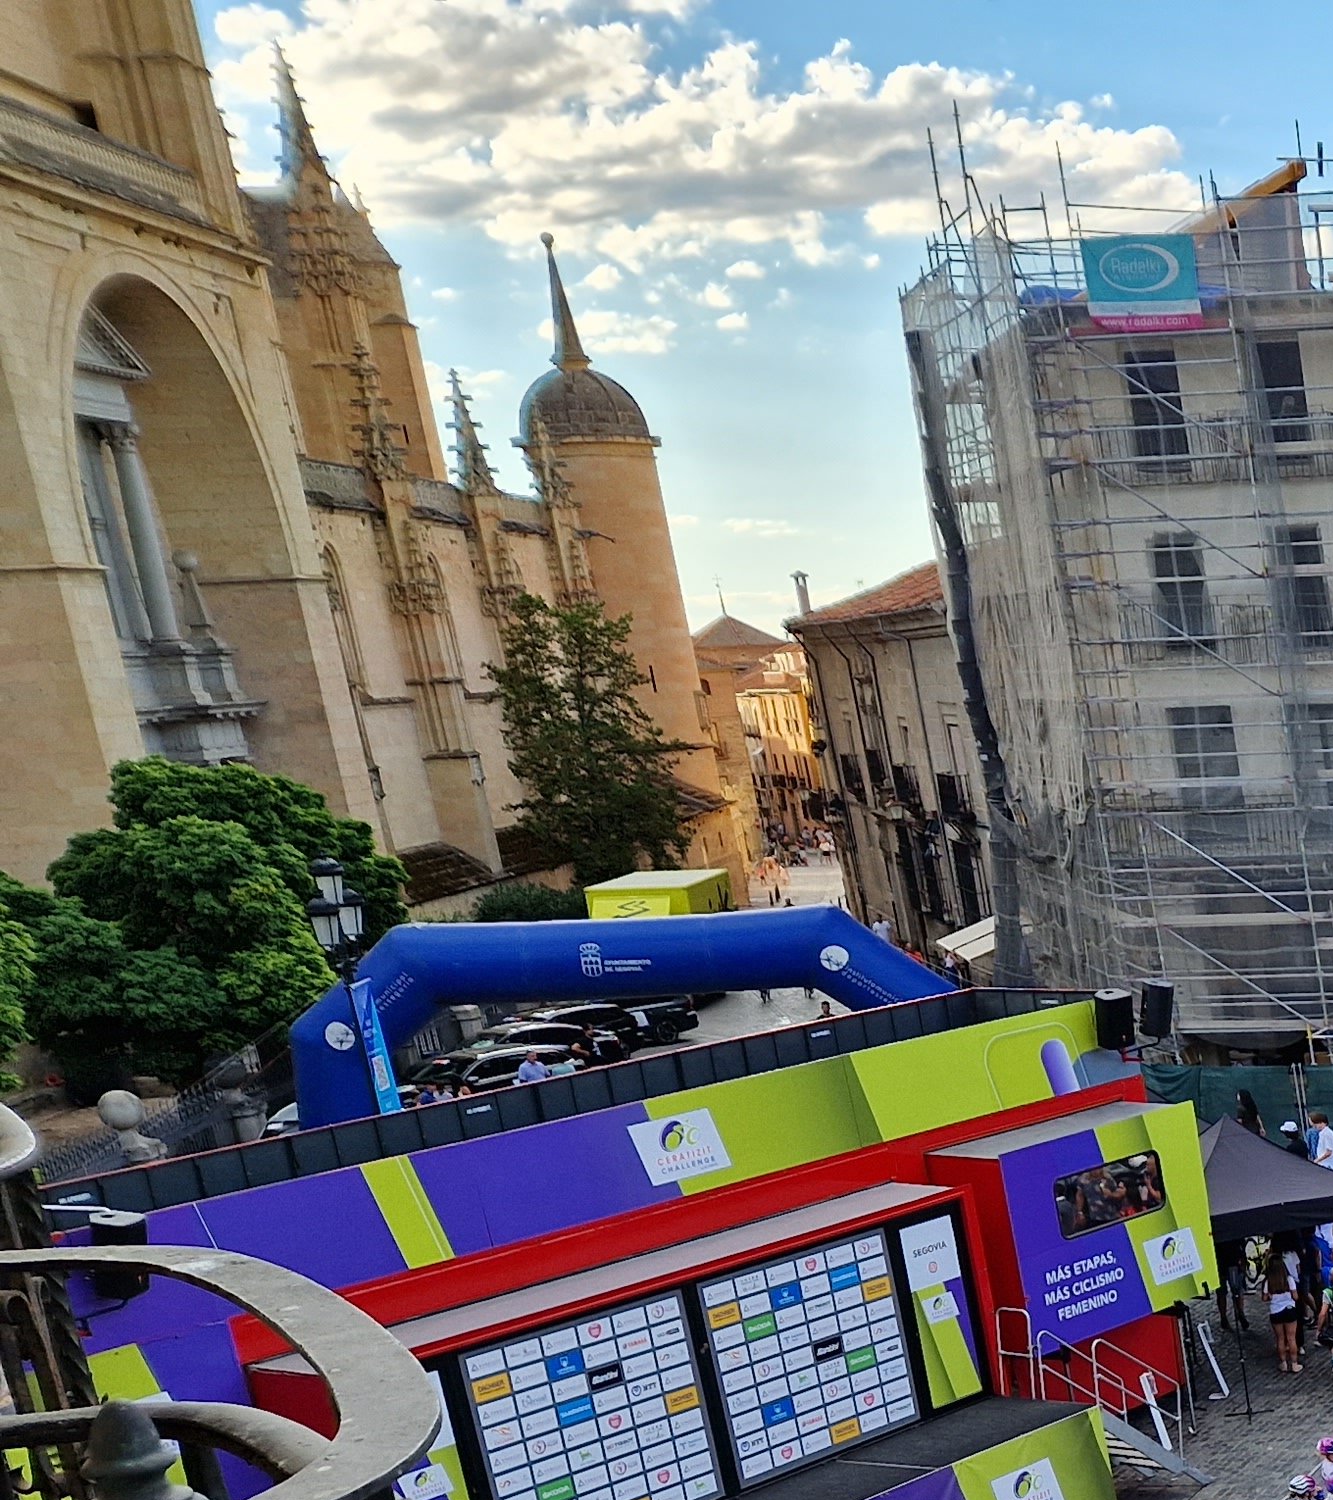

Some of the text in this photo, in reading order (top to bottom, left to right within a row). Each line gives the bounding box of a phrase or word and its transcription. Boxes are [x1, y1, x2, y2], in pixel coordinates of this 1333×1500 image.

[1110, 257, 1161, 275] Radalki
[1100, 315, 1190, 328] www.radalki.com
[657, 1145, 712, 1166] CERATIZIT
[661, 1156, 716, 1174] CHALLENGE
[912, 1240, 947, 1259] SEGOVIA
[1045, 1250, 1117, 1286] MÁS ETAPAS,
[1045, 1268, 1124, 1307] MÁS CICLISMO
[1057, 1289, 1118, 1322] FEMENINO
